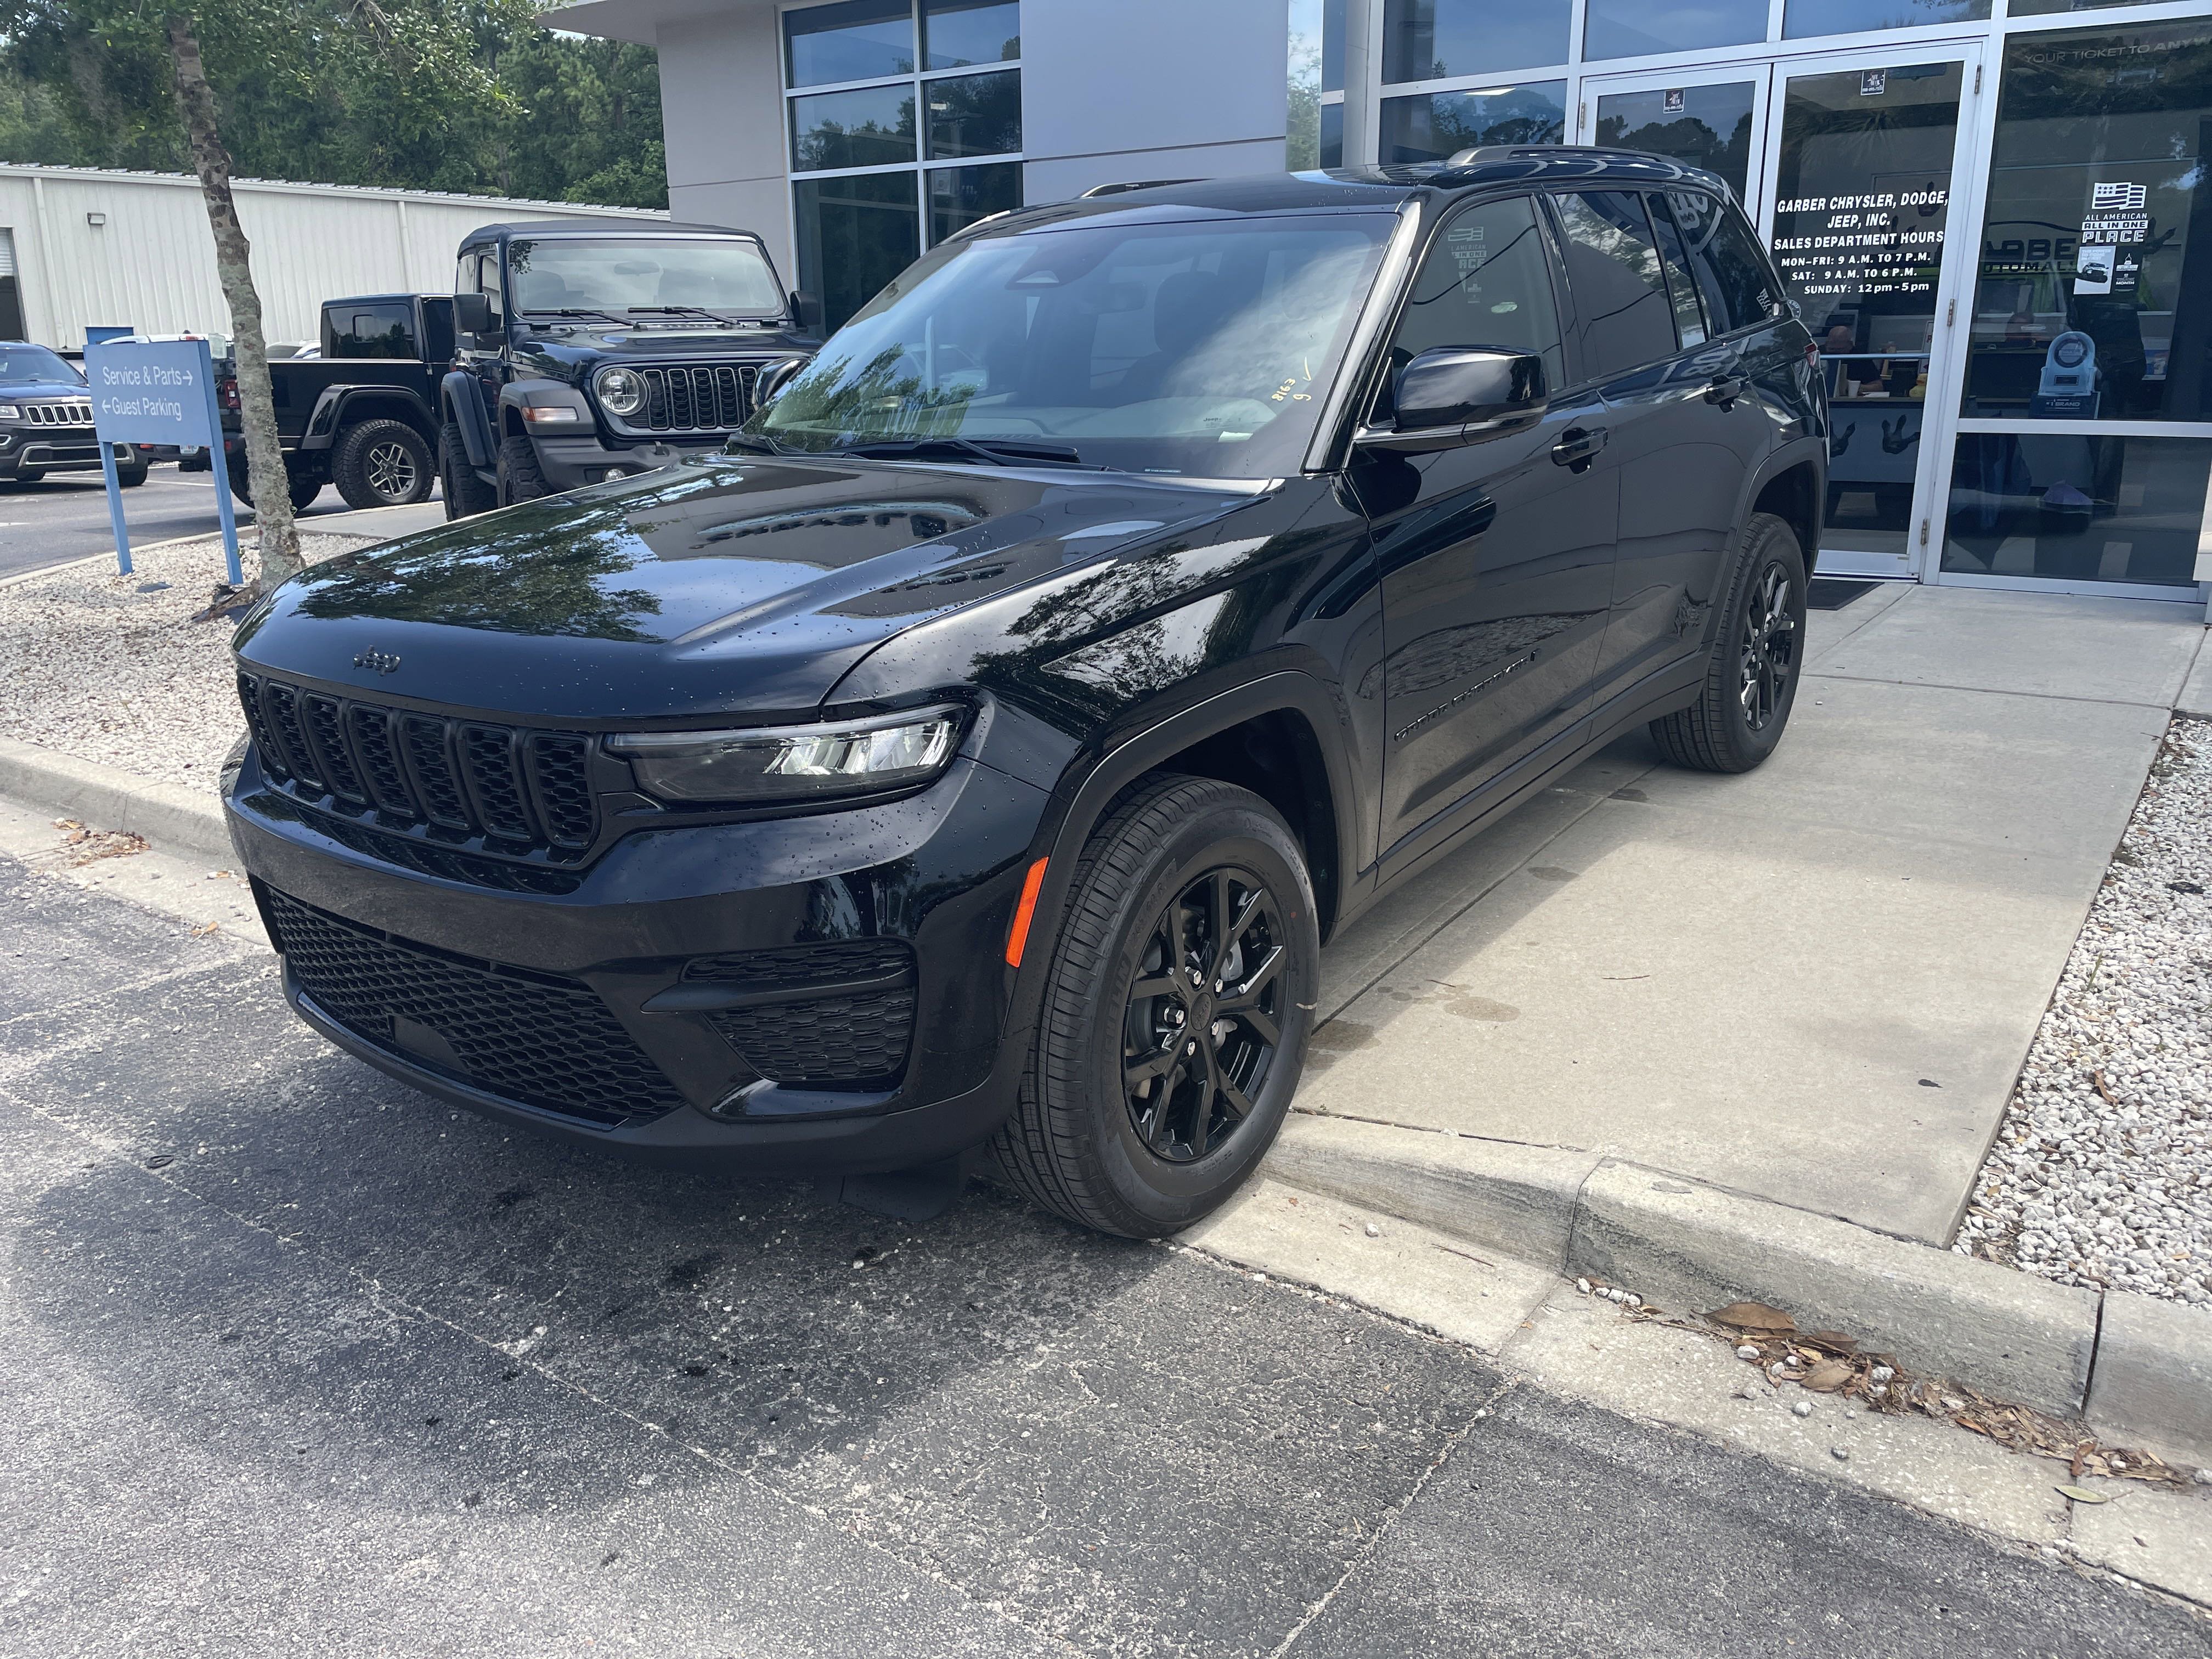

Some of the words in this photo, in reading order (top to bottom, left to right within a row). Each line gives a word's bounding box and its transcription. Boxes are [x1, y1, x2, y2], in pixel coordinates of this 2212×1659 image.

[2025, 52, 2066, 64] YOUR
[2073, 47, 2126, 60] TICKET
[2129, 44, 2151, 54] TO
[1777, 198, 1826, 213] GARBER
[1830, 194, 1897, 210] CHRYSLER,
[1900, 190, 1948, 206] DODGE,
[1827, 215, 1861, 229] JEEP,
[1865, 212, 1891, 227] INC.
[2103, 212, 2148, 221] AMERICAN
[1774, 237, 1812, 250] SALES
[1814, 233, 1897, 248] DEPARTMENT
[1900, 230, 1944, 244] HOURS
[2082, 230, 2145, 243] PLACE
[1781, 256, 1834, 267] MON-FRI:
[1838, 256, 1845, 264] 9
[1848, 254, 1874, 264] A.M.
[1878, 253, 1892, 263] TO
[1895, 253, 1902, 262] 7
[1905, 252, 1931, 262] P.M.
[1791, 271, 1815, 280] SAT:
[1825, 271, 1831, 279] 9
[1835, 269, 1860, 279] A.M.
[1864, 269, 1878, 278] TO
[1882, 268, 1888, 277] 6
[1892, 267, 1917, 276] P.M.
[1804, 284, 1851, 294] SUNDAY:
[103, 365, 140, 385] Service
[143, 366, 151, 385] &
[153, 366, 182, 385] Parts
[112, 397, 142, 416] Guest
[143, 397, 182, 421] Parking
[354, 645, 400, 676] Jeep
